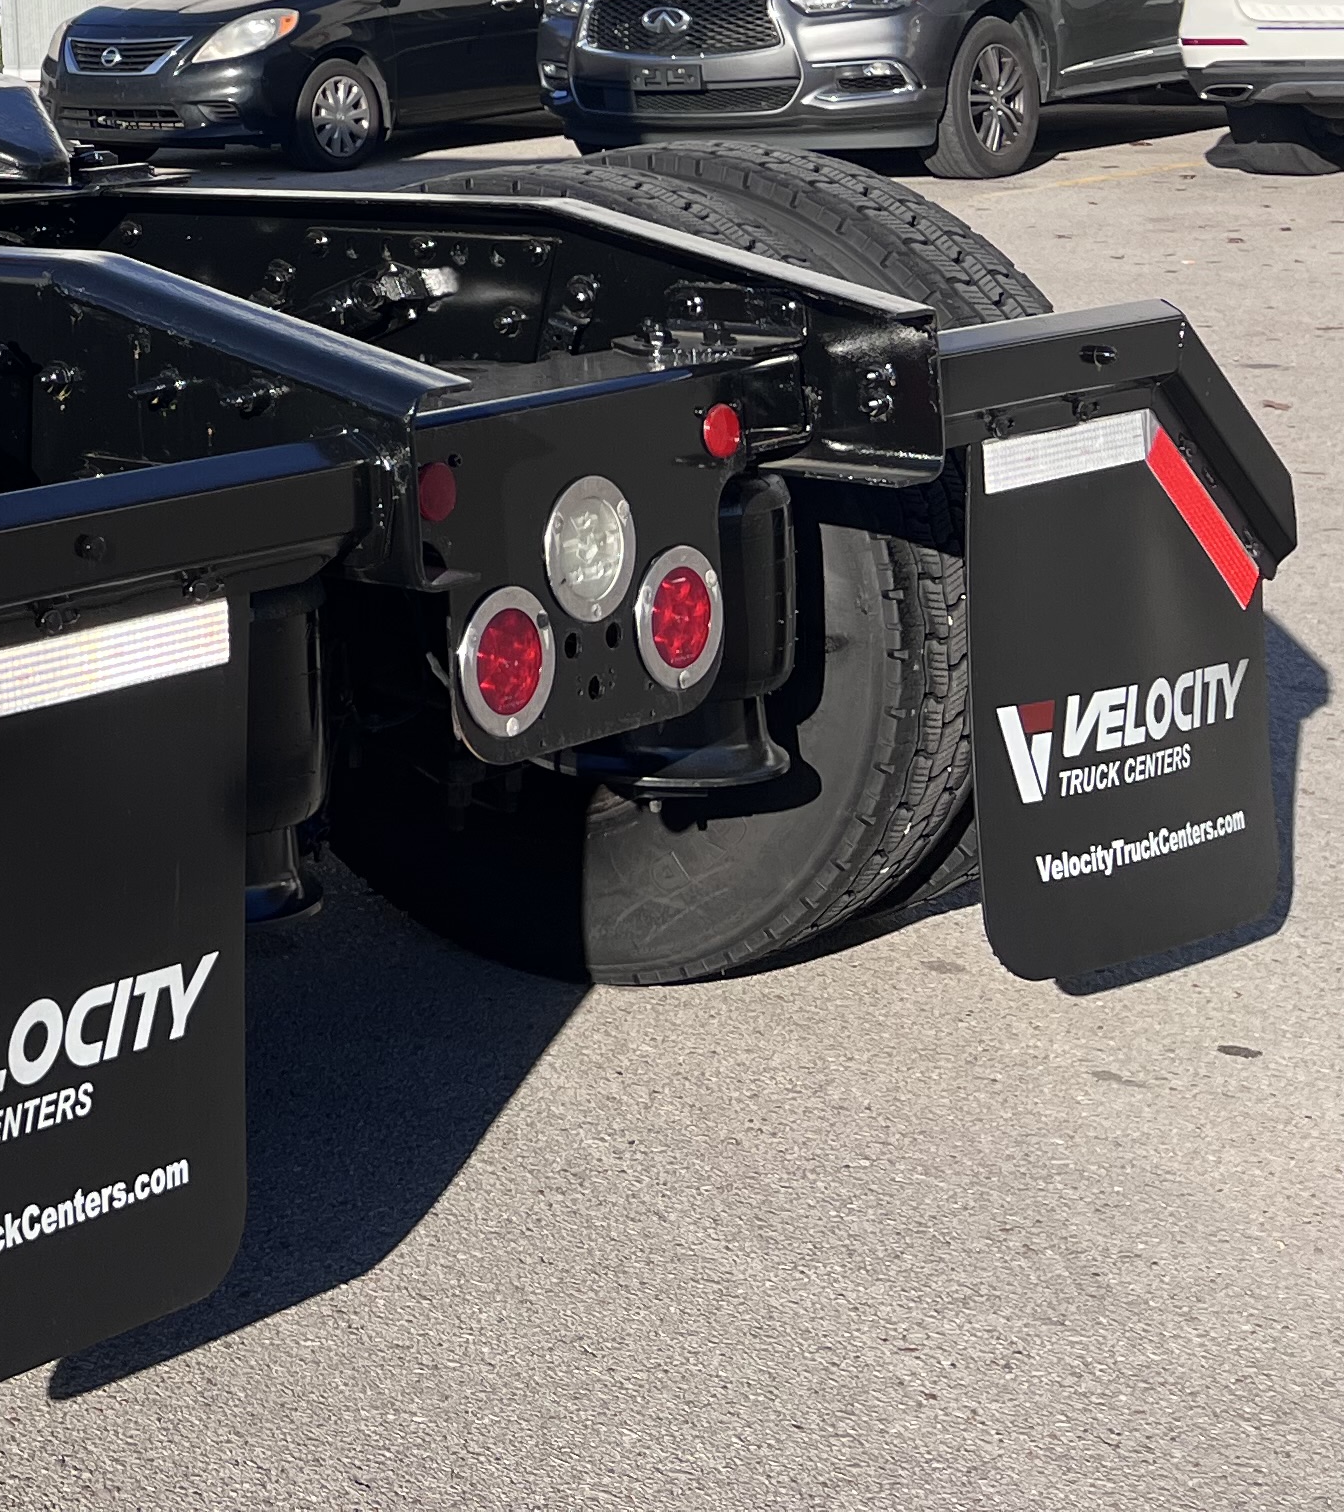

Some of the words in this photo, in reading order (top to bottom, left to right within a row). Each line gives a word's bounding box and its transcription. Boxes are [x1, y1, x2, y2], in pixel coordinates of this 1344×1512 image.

[1063, 658, 1249, 758] VELOCITY
[1059, 761, 1119, 797] TRUCK
[1124, 743, 1192, 785] CENTERS
[1036, 810, 1246, 883] VelocityTruckCenters.com
